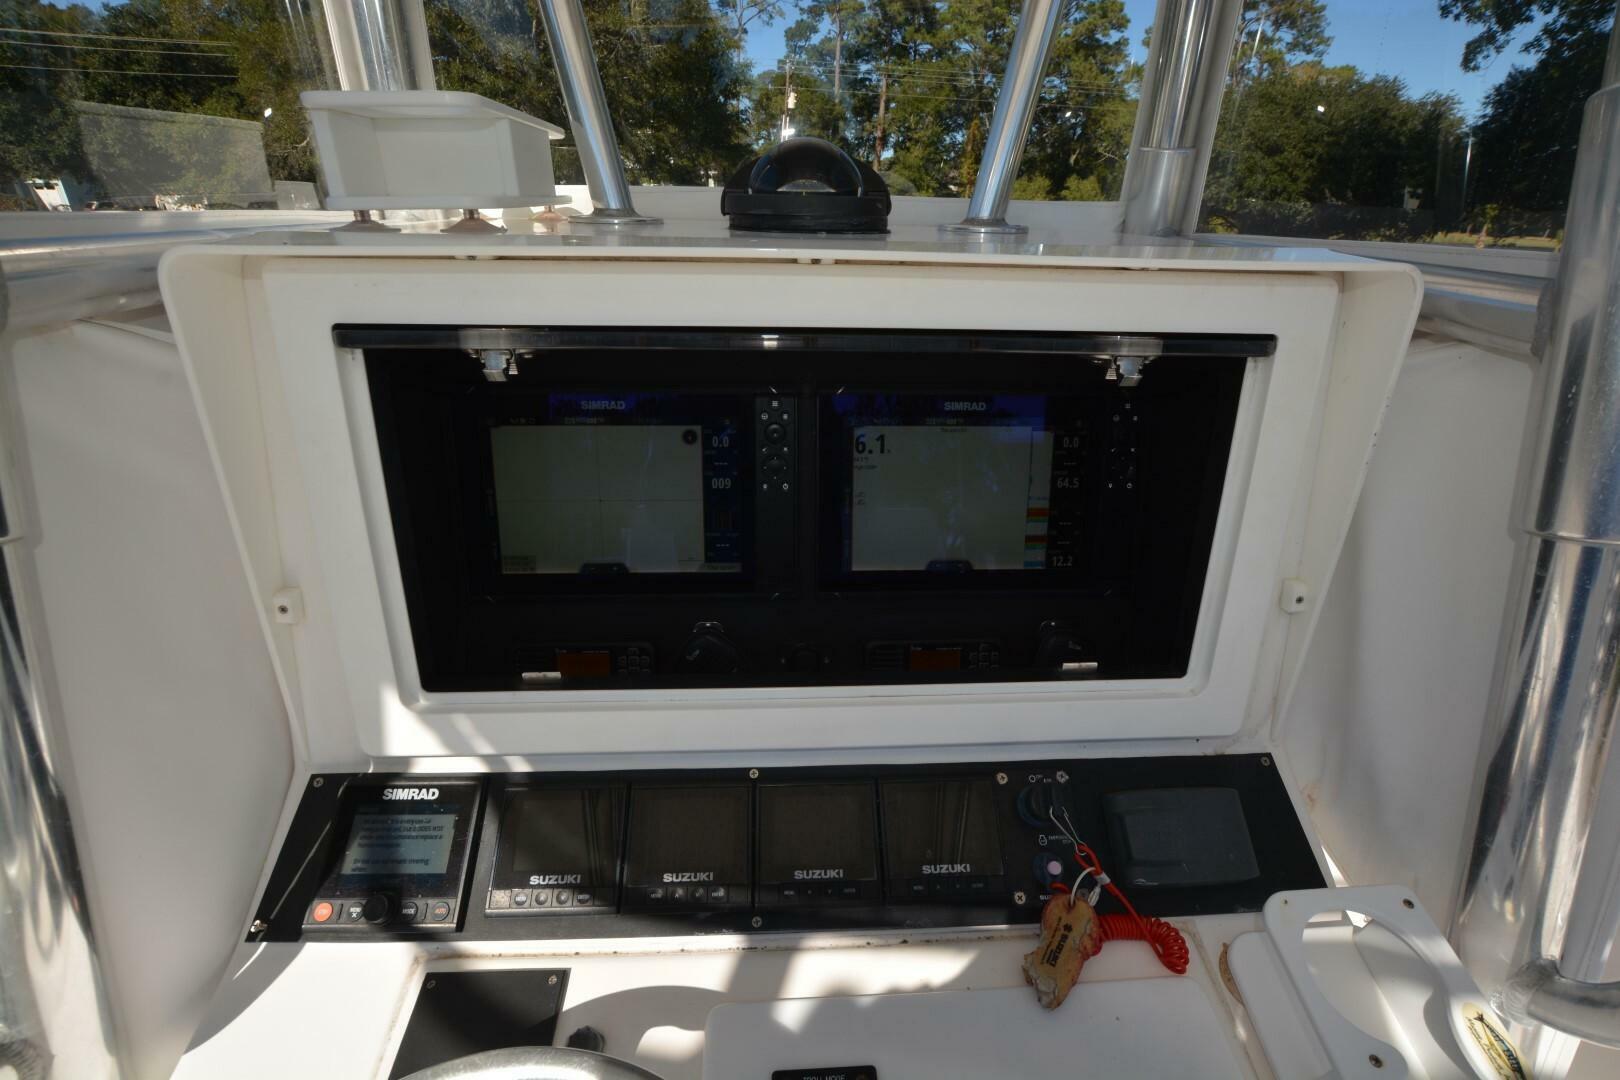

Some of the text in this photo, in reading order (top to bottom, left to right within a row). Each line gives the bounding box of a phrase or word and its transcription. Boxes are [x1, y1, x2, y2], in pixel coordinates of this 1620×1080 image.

[580, 400, 626, 411] SIMRAD
[943, 401, 987, 412] SIMRAD
[712, 435, 729, 448] 0.0
[855, 433, 885, 454] 6.1
[1063, 436, 1079, 448] 0.0
[711, 477, 732, 489] 009
[1056, 477, 1080, 489] 64.5
[1051, 555, 1073, 567] 12.2
[382, 788, 439, 801] SIMRAD
[793, 868, 844, 880] SUZUKI
[921, 863, 971, 874] SUZUKI
[529, 874, 581, 885] SUZUKI
[662, 871, 714, 883] SUZUKI
